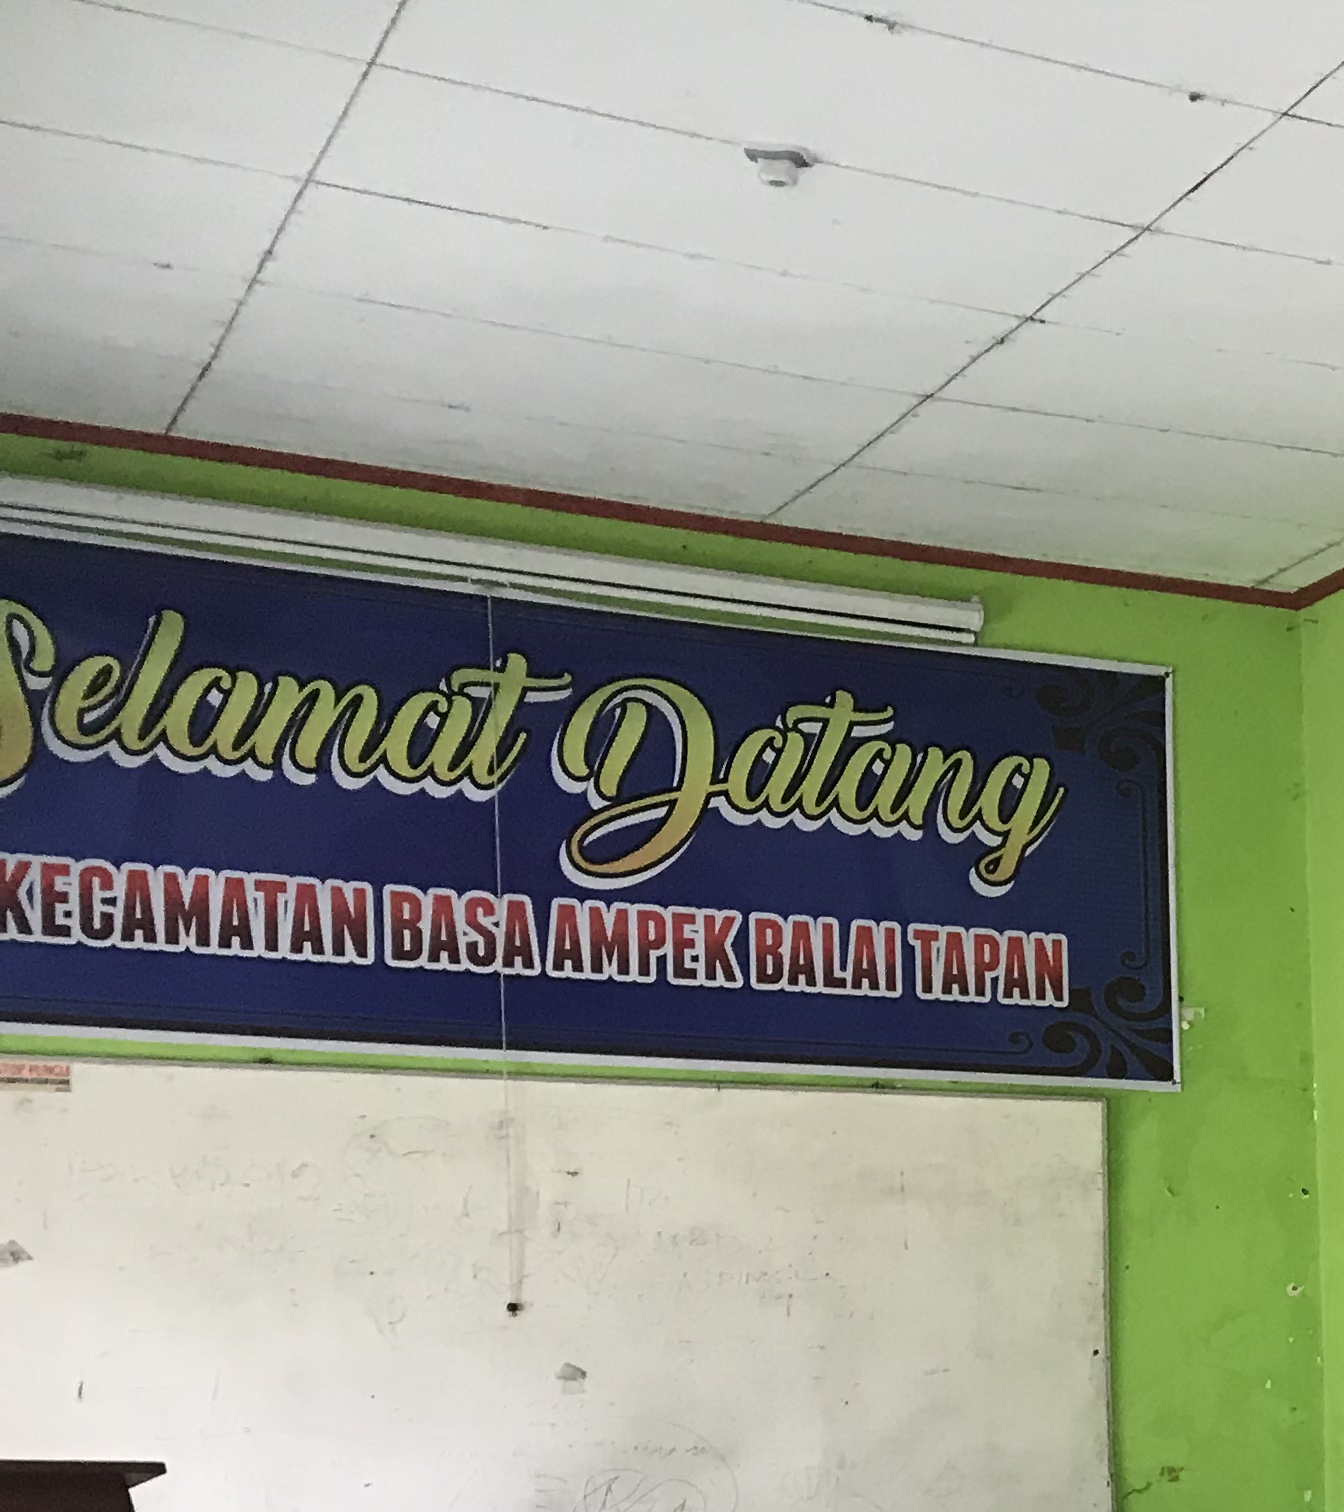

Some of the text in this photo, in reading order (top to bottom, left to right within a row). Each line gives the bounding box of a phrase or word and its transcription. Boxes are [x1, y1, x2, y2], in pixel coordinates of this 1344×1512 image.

[554, 674, 1068, 894] Datang
[0, 856, 1069, 1005] KECAMATAN BASA AMPEK BALAI TAPAN
